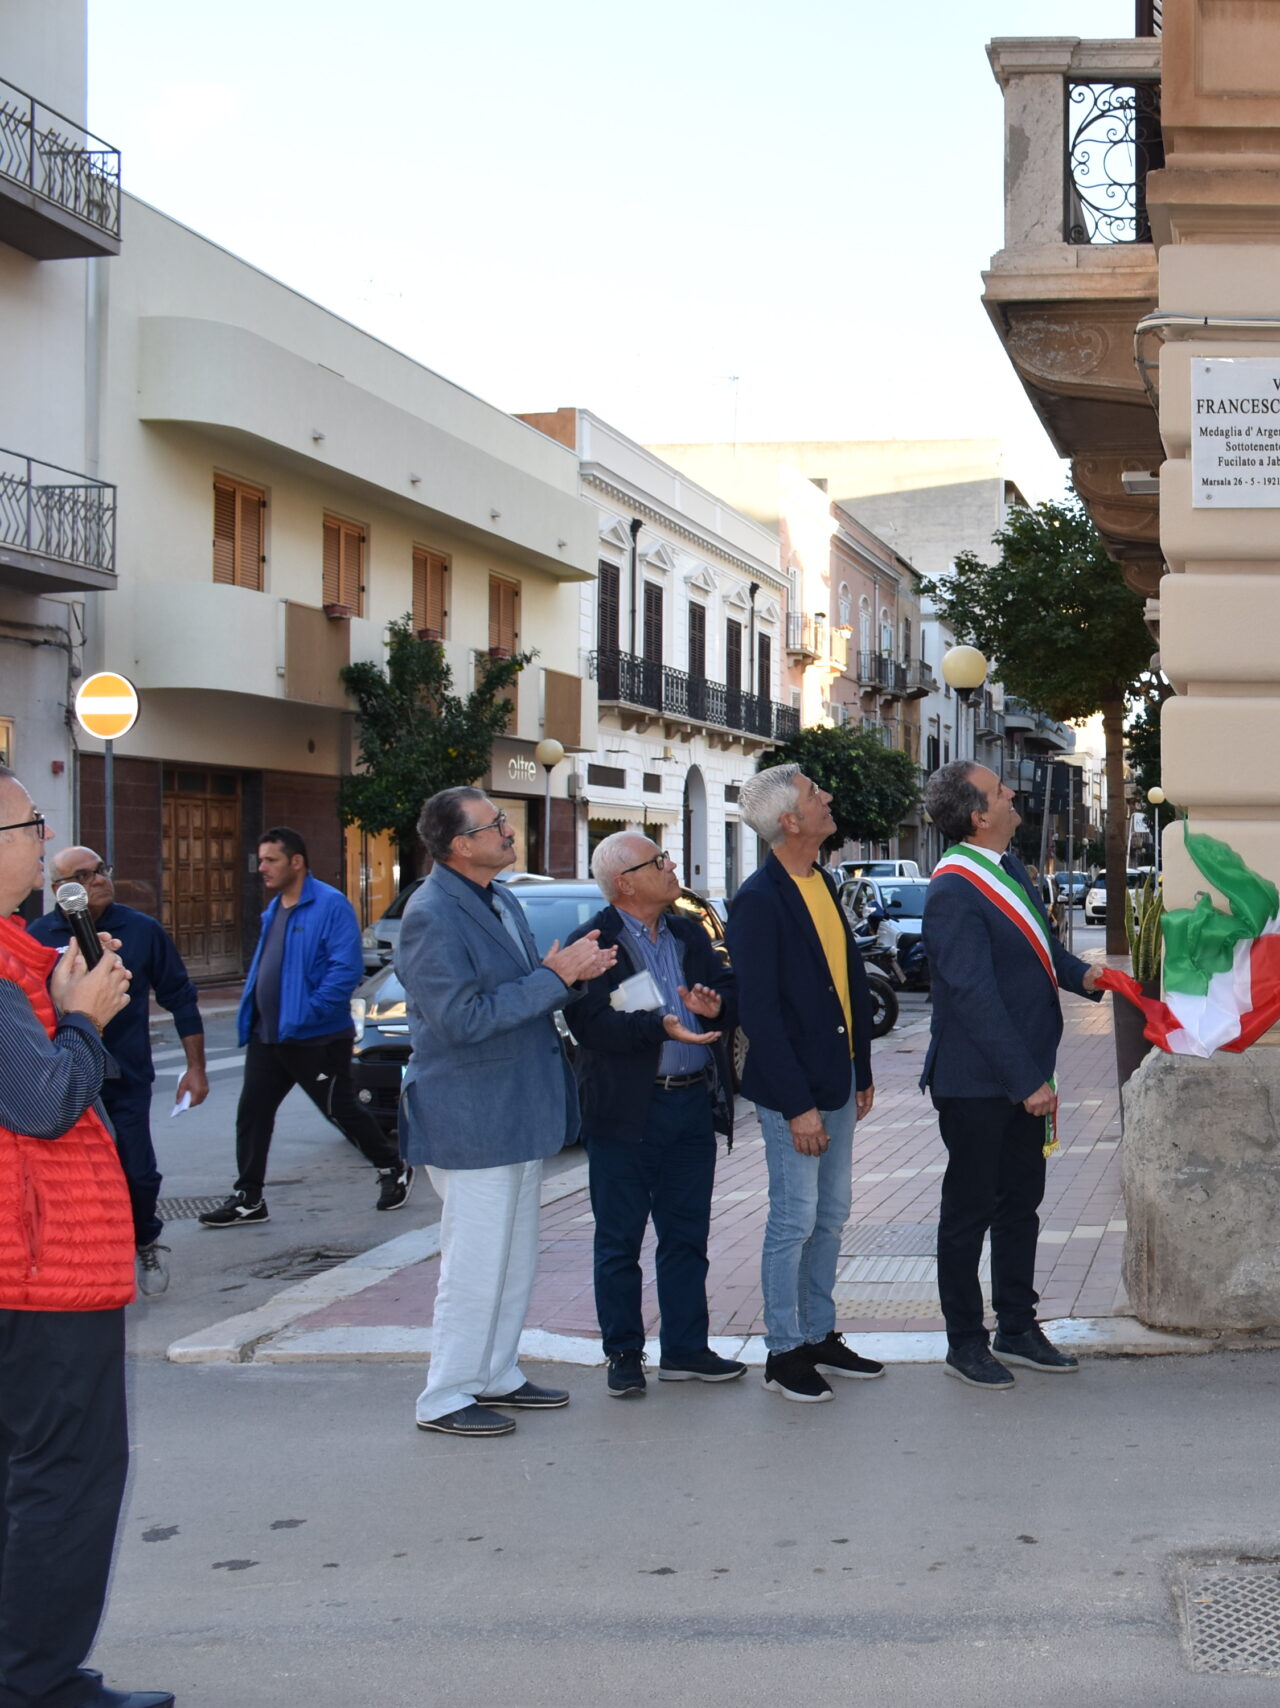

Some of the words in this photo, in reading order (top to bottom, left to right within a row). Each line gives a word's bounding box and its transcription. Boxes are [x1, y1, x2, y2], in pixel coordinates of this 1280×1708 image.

[1199, 426, 1243, 439] Medaglia
[1244, 426, 1254, 437] d'
[1217, 456, 1257, 467] Fucilato
[1258, 458, 1265, 467] a
[1201, 477, 1232, 486] Marsala
[1233, 477, 1243, 486] 26
[1263, 477, 1280, 486] 1921
[508, 754, 536, 782] oltre
